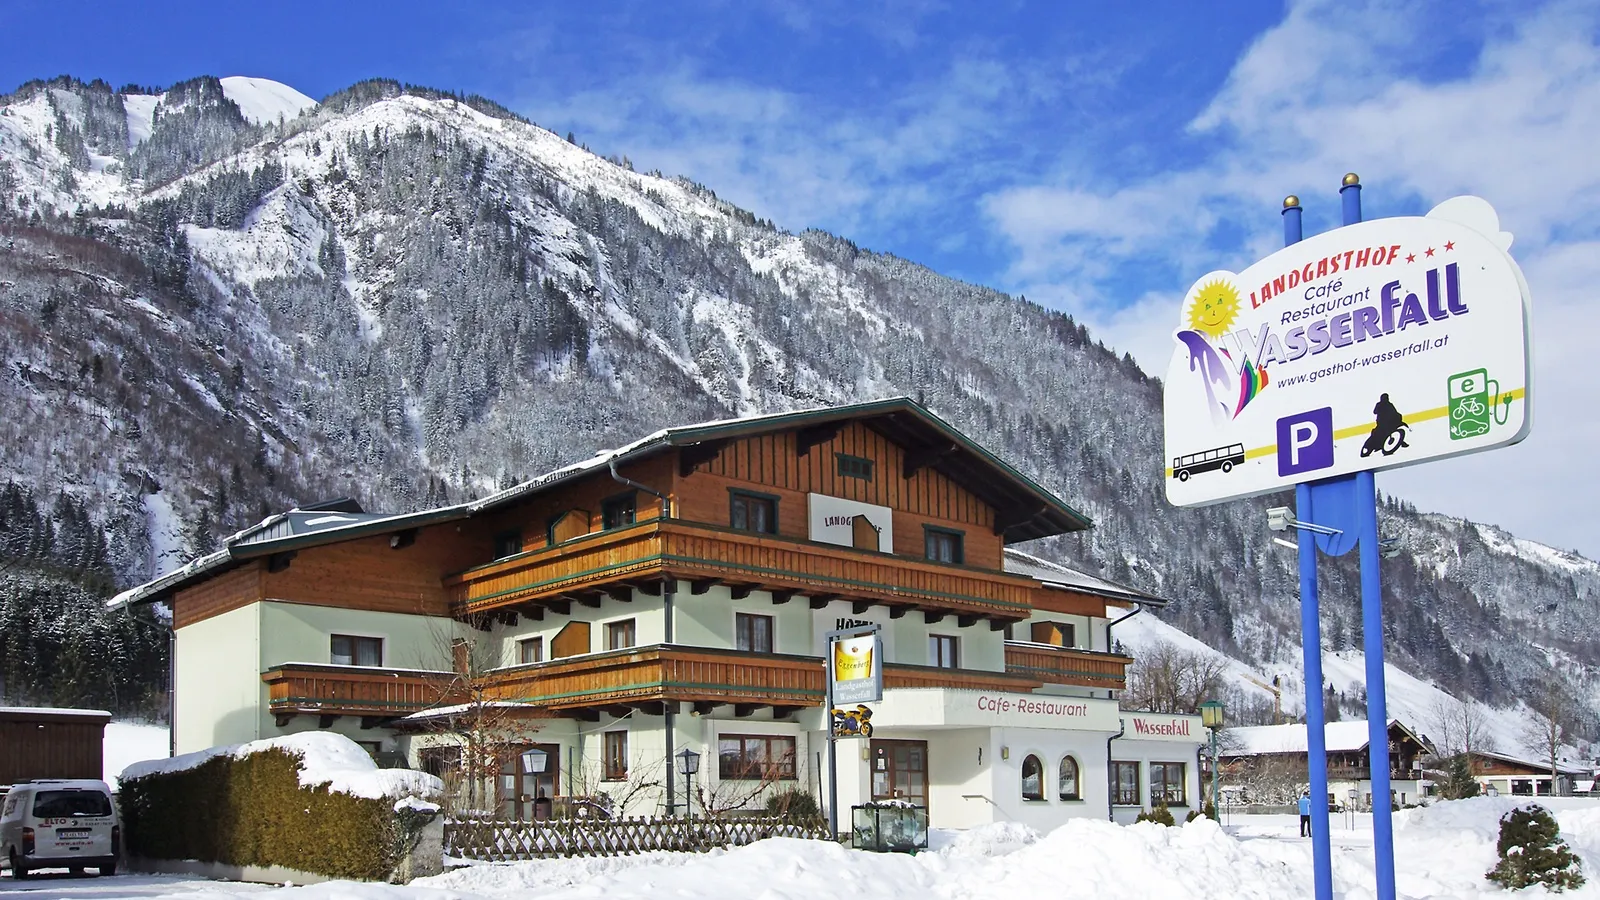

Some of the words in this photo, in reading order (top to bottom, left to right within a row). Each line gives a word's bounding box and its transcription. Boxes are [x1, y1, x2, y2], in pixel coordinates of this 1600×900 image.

[1250, 245, 1401, 310] LANDGASTHOF
[1304, 278, 1343, 302] Café
[1280, 287, 1370, 326] Restaurant
[1277, 335, 1450, 389] www.gasthof-wasserfall.at
[1290, 420, 1319, 466] P
[835, 680, 874, 691] Landgasthof
[840, 690, 871, 701] Wasserfall
[978, 695, 1087, 717] Cafe-Restaurant
